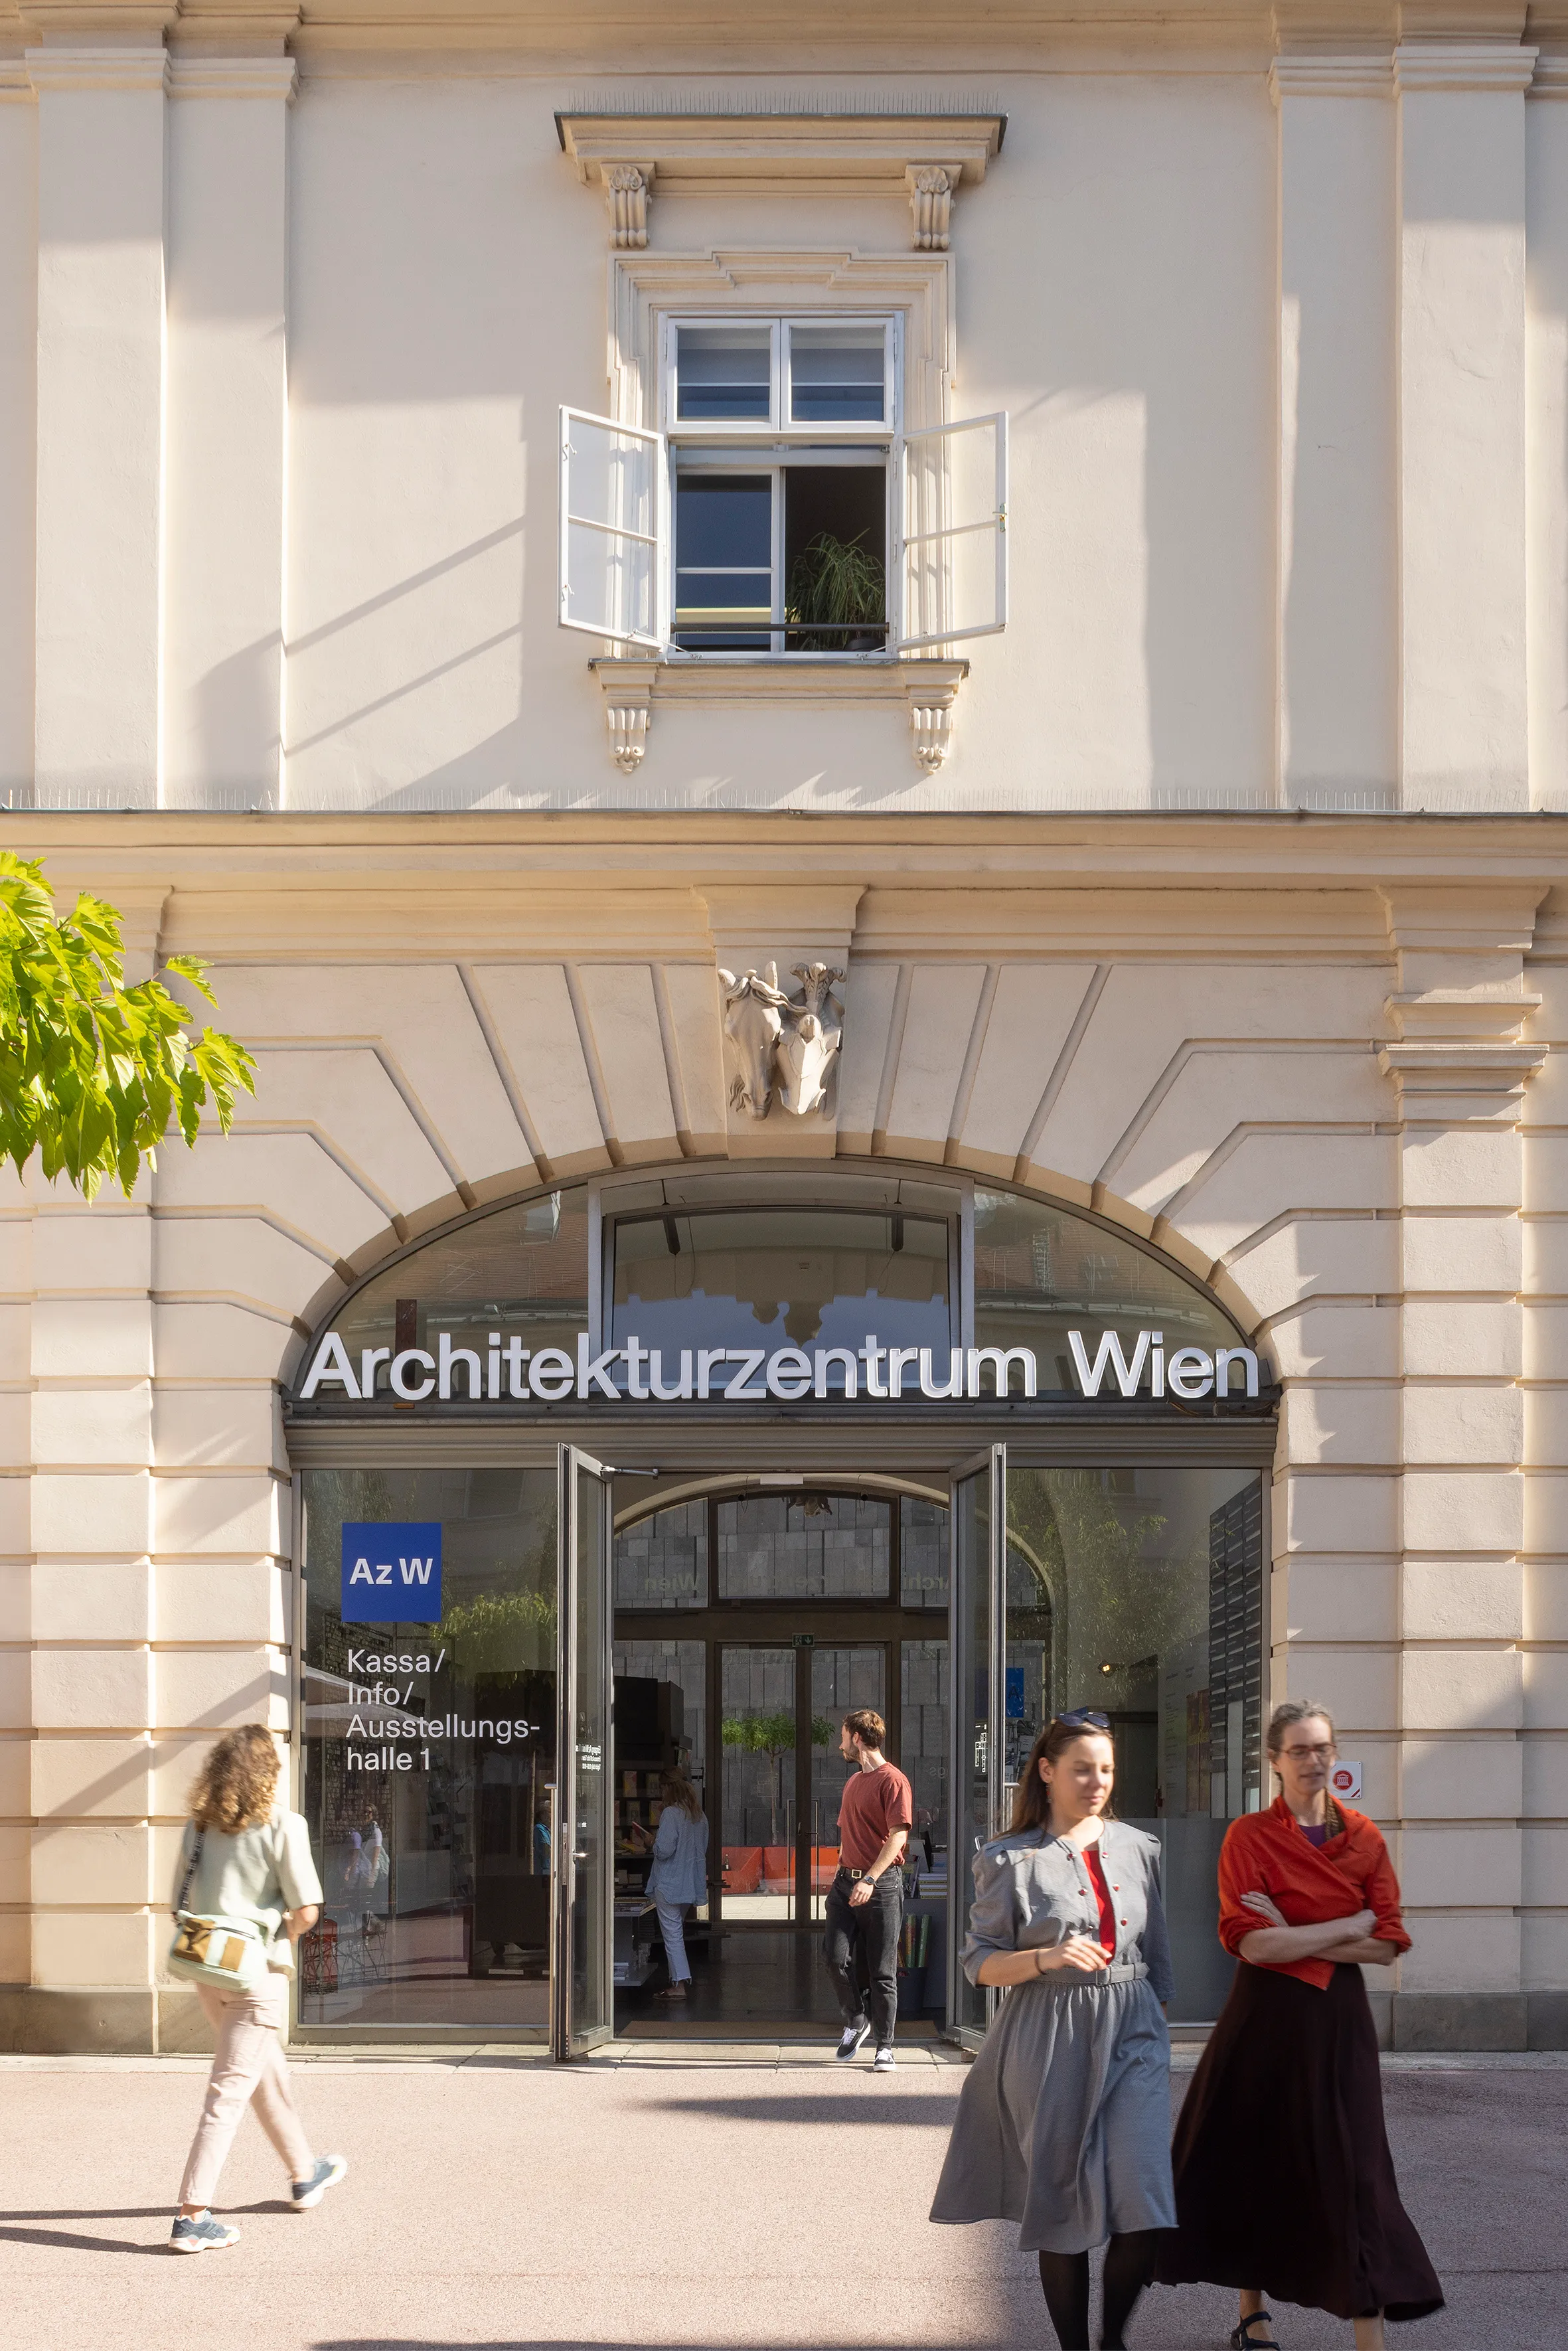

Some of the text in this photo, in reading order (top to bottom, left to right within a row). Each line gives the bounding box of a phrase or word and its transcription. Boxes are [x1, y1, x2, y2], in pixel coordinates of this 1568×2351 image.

[299, 1331, 1259, 1400] Architekturzentrum Wien
[348, 1649, 445, 1672] Kassa/
[349, 1681, 414, 1706] Info/
[345, 1714, 540, 1744] Ausstellungs-
[347, 1747, 430, 1770] halle 1
